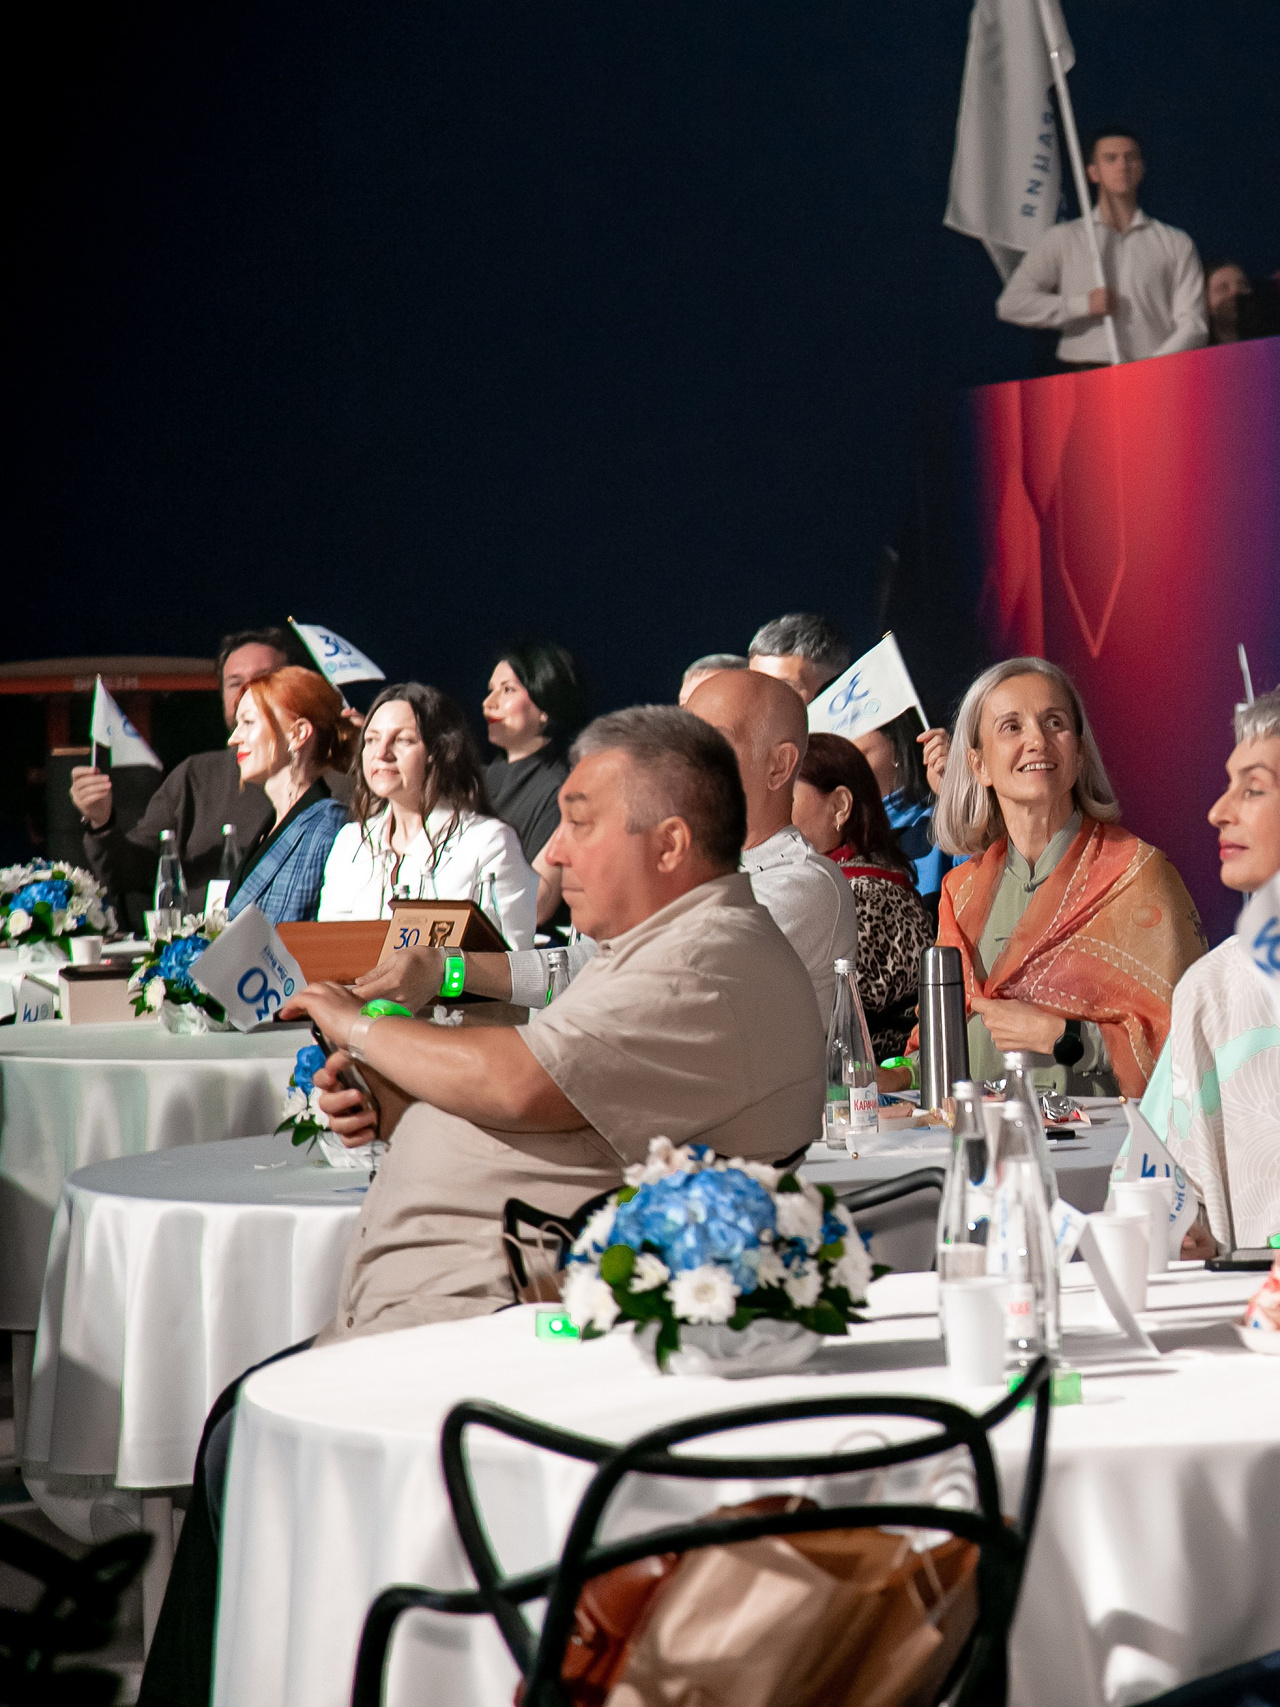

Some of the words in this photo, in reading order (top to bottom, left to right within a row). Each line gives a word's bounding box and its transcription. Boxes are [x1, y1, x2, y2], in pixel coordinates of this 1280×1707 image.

[319, 633, 353, 658] 30
[393, 927, 421, 951] 30
[237, 966, 282, 1022] 30
